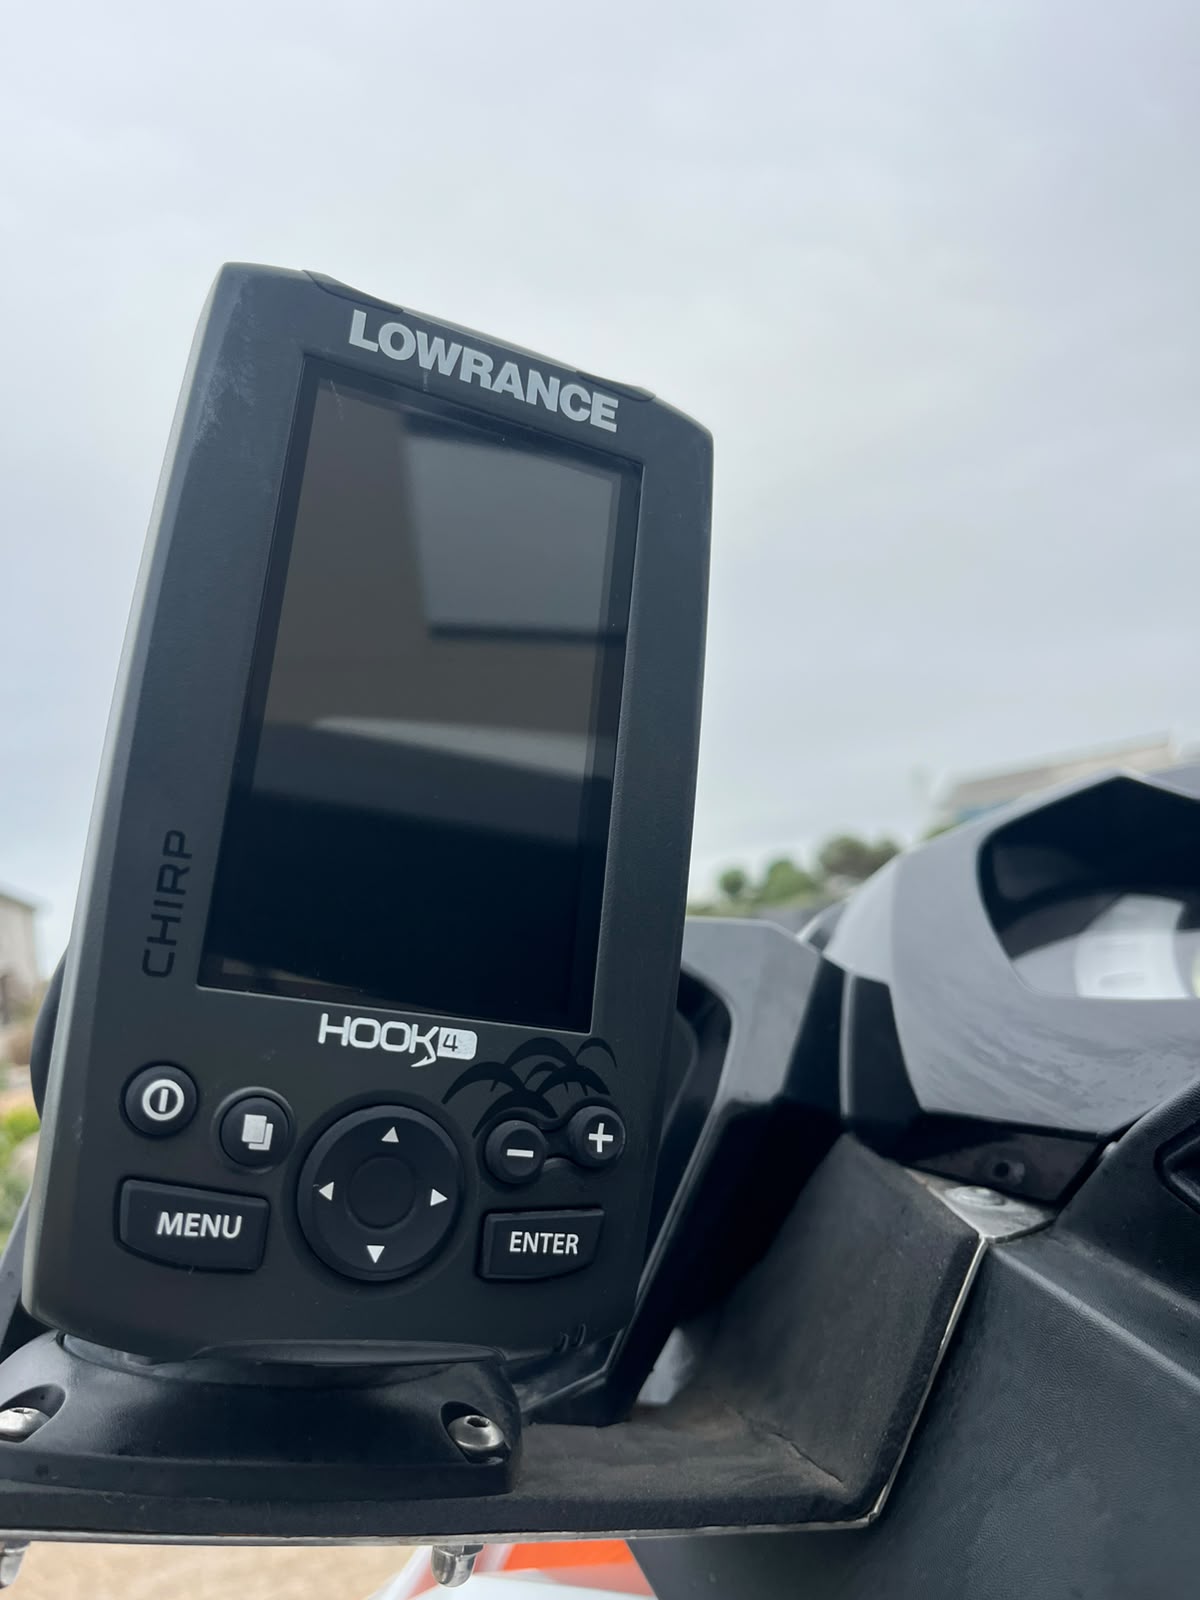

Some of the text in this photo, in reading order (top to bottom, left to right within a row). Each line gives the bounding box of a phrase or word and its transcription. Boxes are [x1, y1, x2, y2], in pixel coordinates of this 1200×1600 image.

[349, 309, 618, 432] LOWRANCE
[142, 829, 192, 978] CHIRP
[156, 1211, 242, 1239] MENU
[509, 1231, 579, 1255] ENTER
